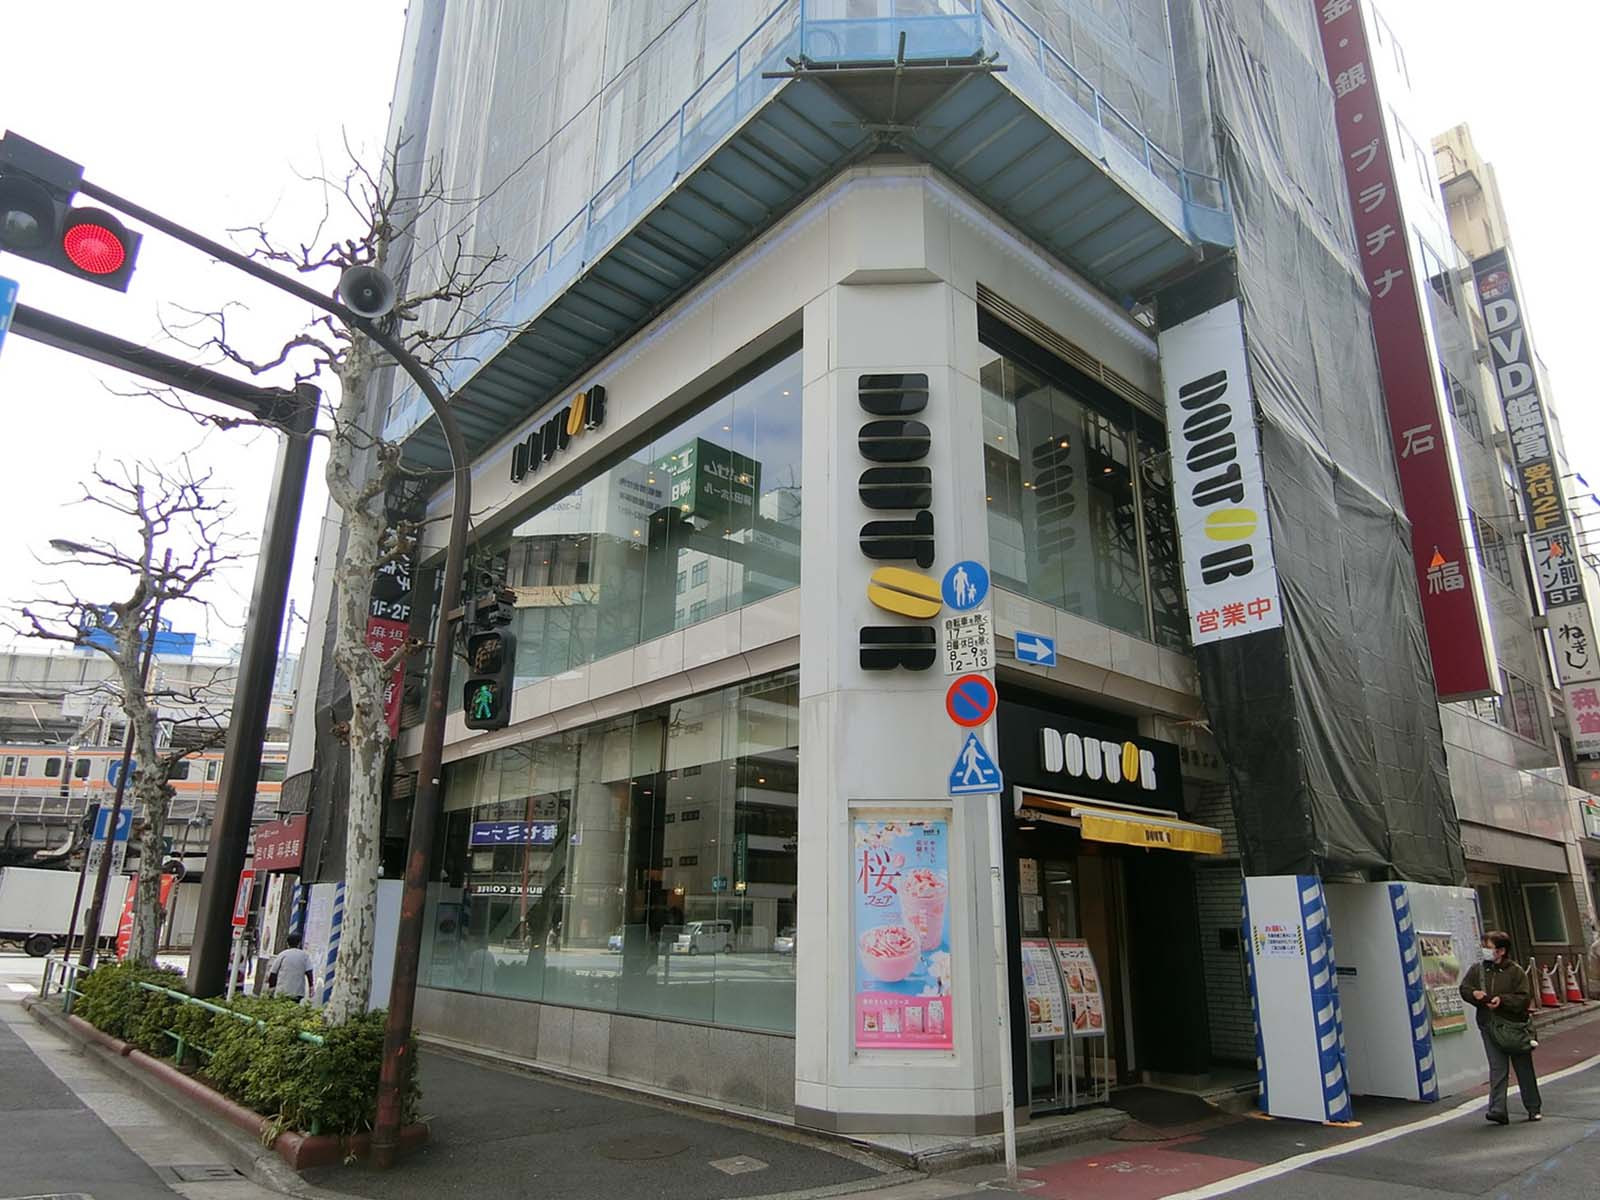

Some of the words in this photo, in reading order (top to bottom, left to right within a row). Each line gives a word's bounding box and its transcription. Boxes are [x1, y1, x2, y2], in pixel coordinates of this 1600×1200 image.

[1178, 369, 1258, 586] DOUTOR
[857, 372, 944, 673] DOUTOR
[1196, 597, 1272, 633] 営業中
[1550, 587, 1579, 604] 5F
[1558, 623, 1590, 670] ねぎし
[1042, 727, 1157, 791] DOUTOR
[857, 850, 902, 894] 桜
[863, 895, 893, 906] フェア
